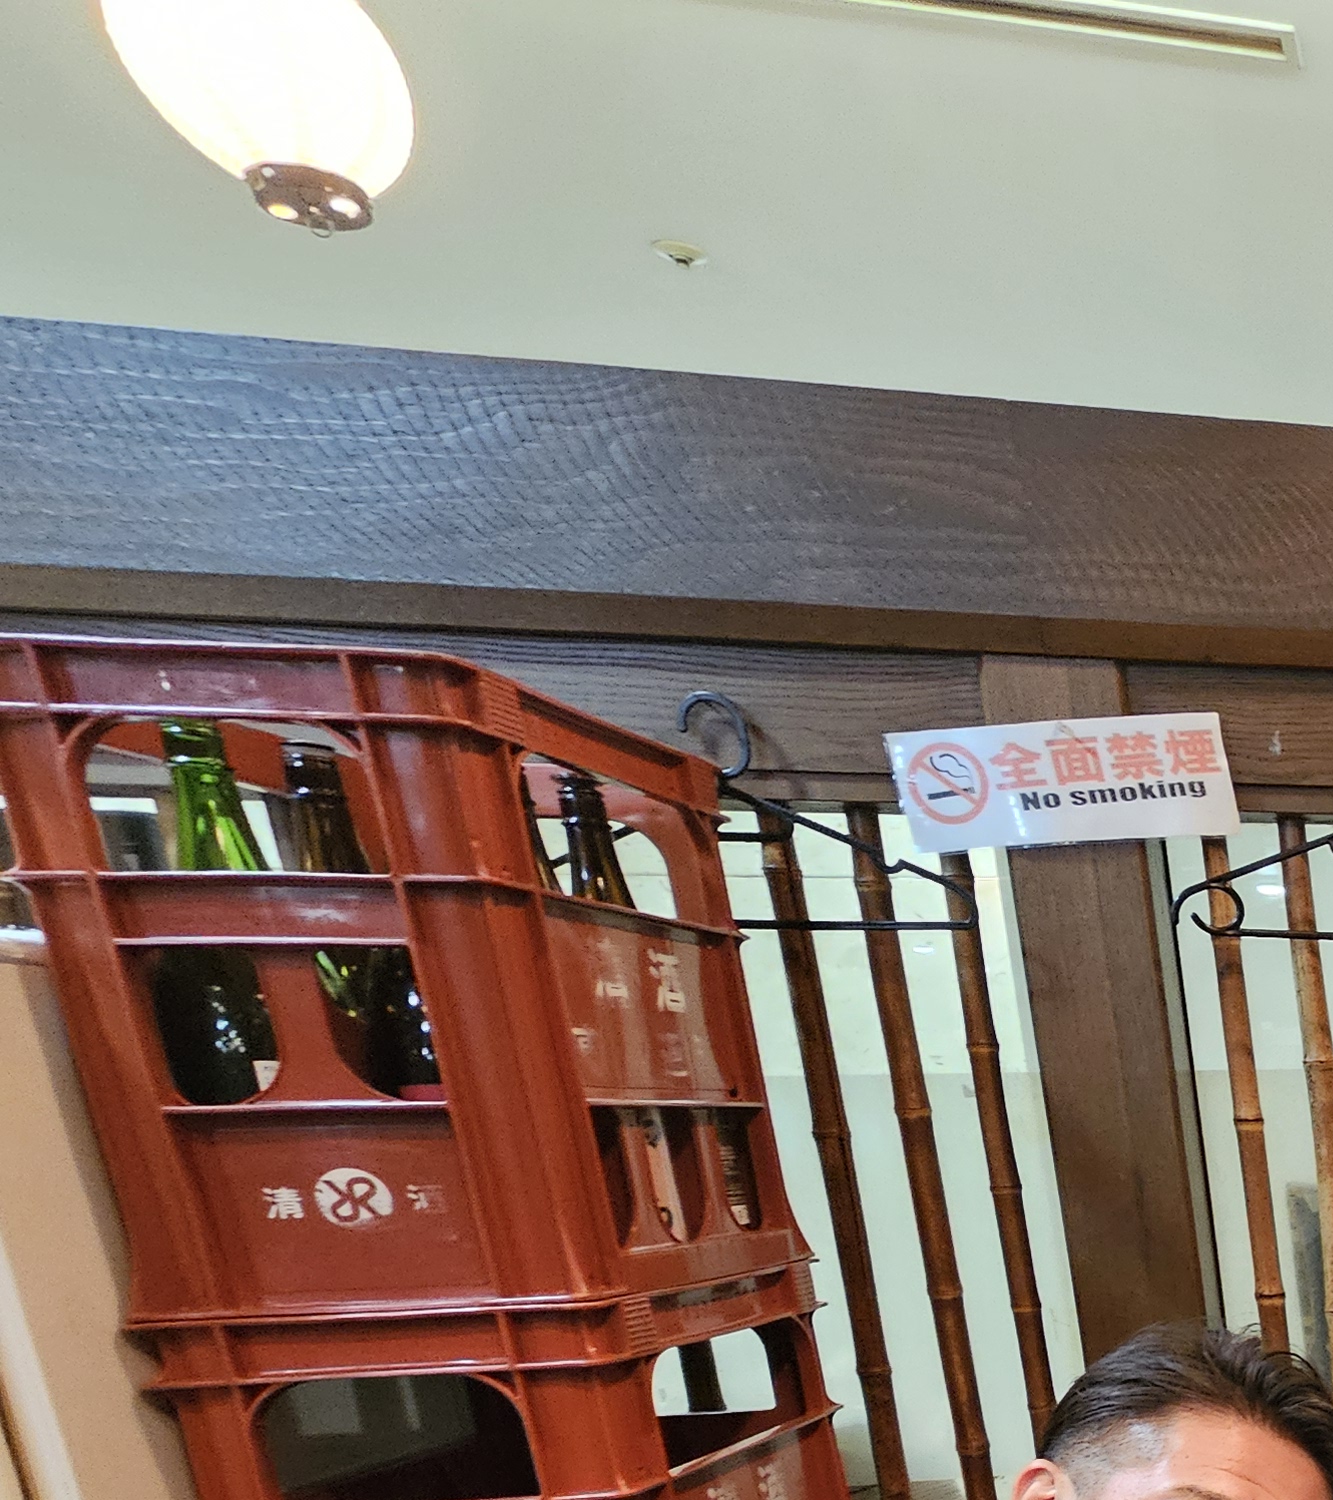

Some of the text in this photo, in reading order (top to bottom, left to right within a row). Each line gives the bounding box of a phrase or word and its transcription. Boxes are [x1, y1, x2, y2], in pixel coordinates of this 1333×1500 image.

[989, 729, 1223, 791] 全面禁煙
[1019, 779, 1207, 811] No smoking
[261, 1186, 305, 1219] 清
